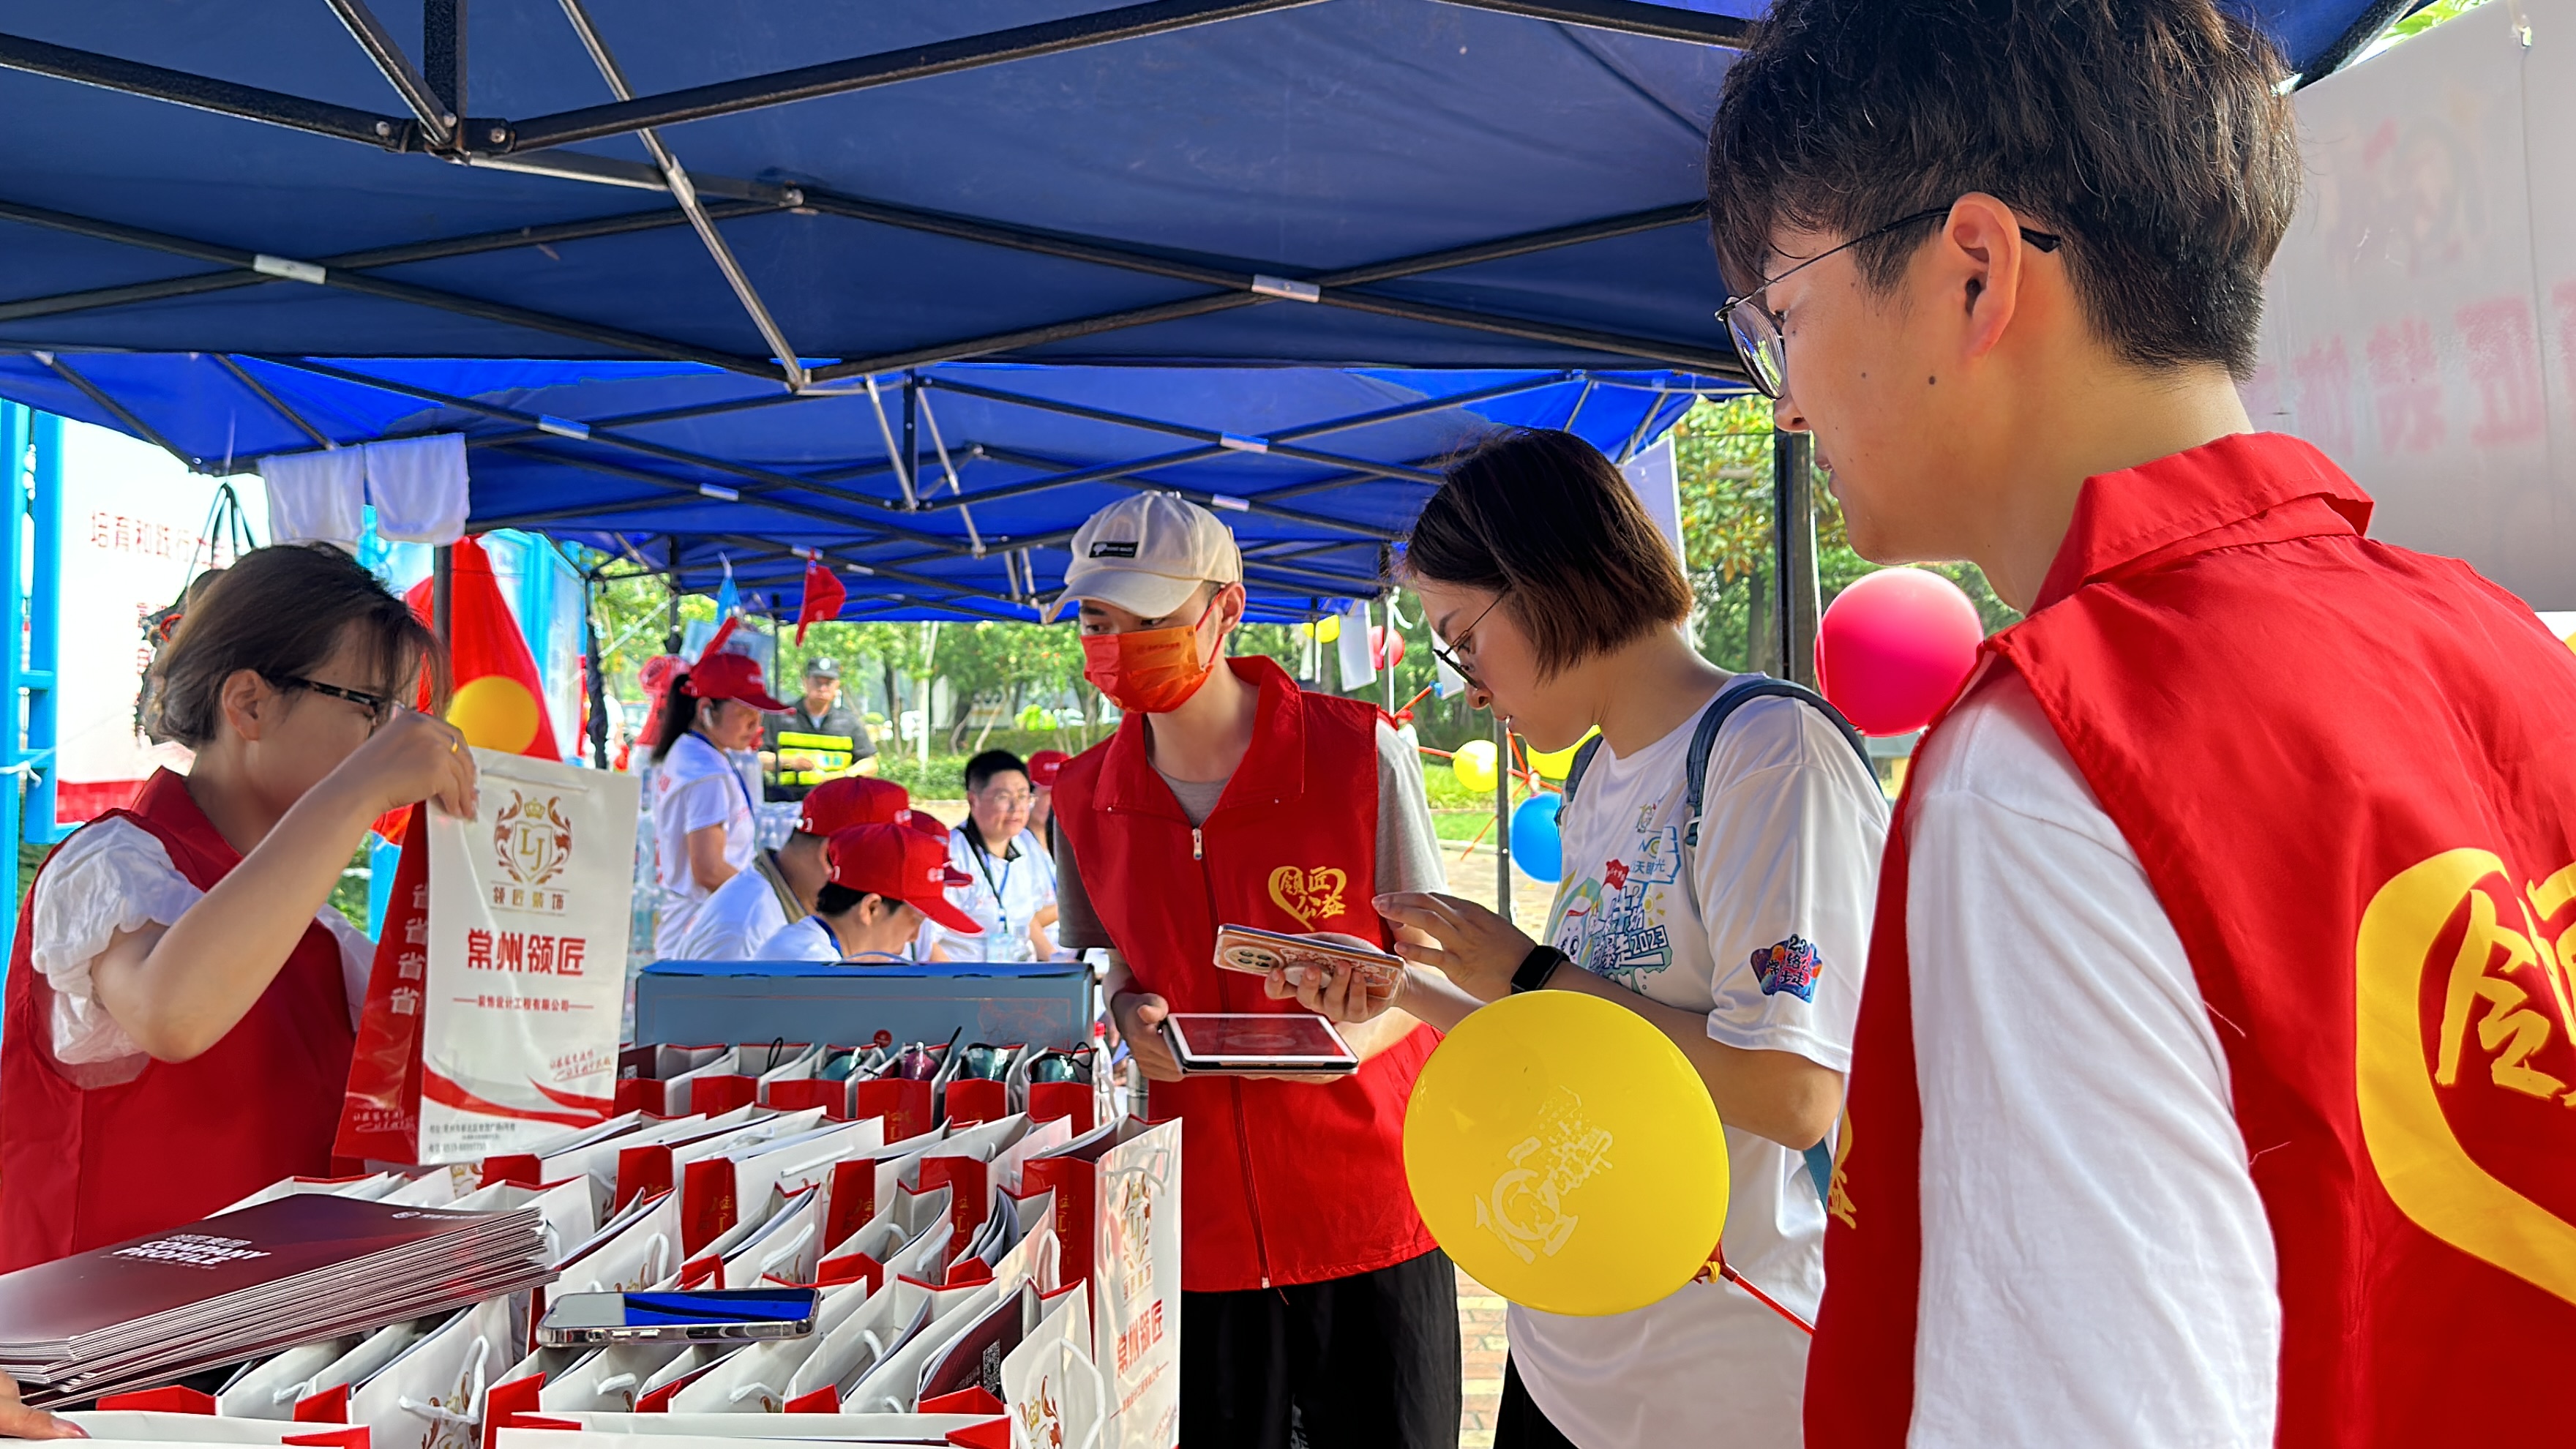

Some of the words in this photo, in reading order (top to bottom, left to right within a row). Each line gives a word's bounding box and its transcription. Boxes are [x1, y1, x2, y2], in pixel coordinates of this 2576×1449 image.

[520, 828, 544, 871] LJ
[468, 927, 586, 978] 常州领匠
[1630, 925, 1669, 954] 2023
[478, 995, 569, 1013] 装饰设计工程有限公司
[112, 1247, 231, 1265] PROFILE
[141, 1240, 272, 1259] COMPANY
[1117, 1298, 1163, 1379] 常州领匠
